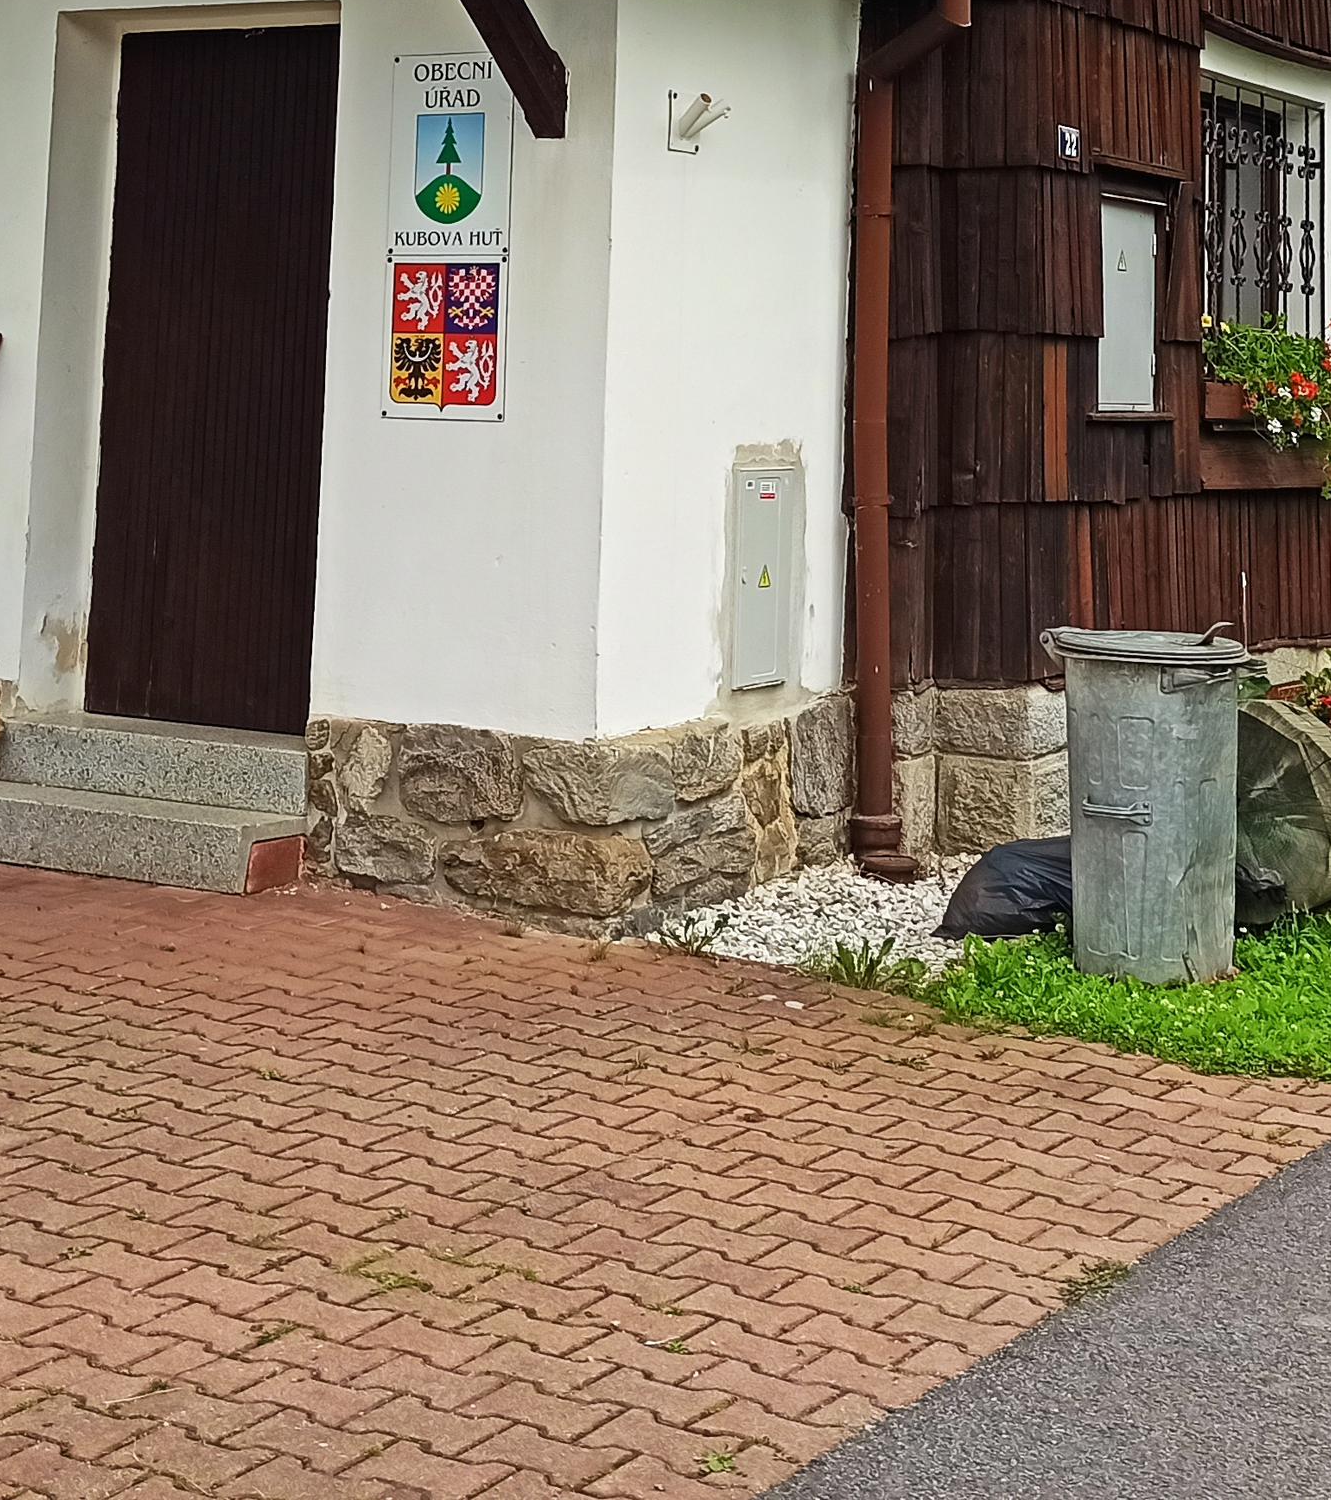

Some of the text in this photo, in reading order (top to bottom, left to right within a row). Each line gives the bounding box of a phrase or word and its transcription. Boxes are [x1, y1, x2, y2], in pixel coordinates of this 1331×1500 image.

[414, 57, 493, 82] OBECNÍ
[425, 86, 481, 109] ÚŘAD
[1065, 132, 1077, 157] 22
[394, 227, 503, 247] KUBOVA HUŤ
